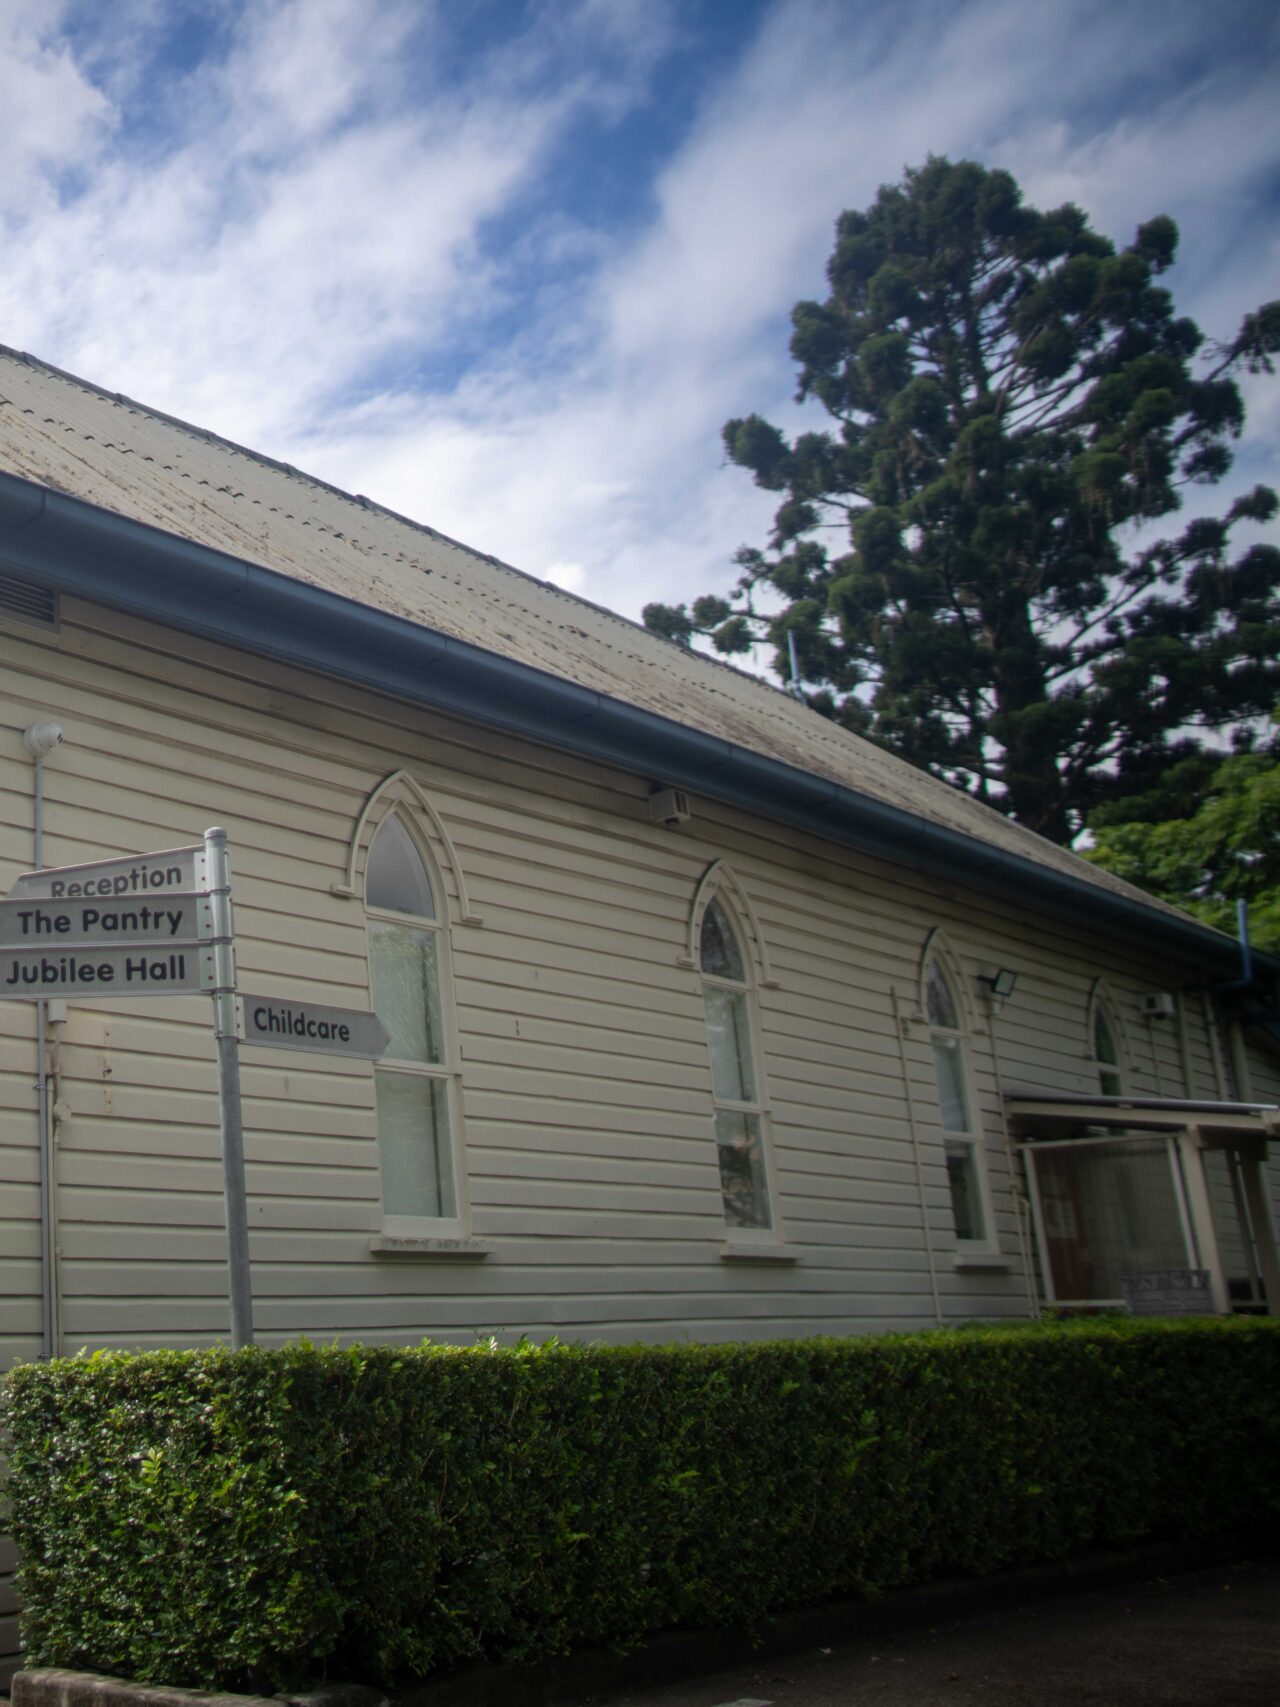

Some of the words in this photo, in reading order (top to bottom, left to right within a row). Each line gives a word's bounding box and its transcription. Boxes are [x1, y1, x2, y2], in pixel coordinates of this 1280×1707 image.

[51, 864, 182, 896] Reception
[17, 909, 72, 935] The
[82, 906, 183, 936] Pantry
[6, 956, 115, 985] Jubilee
[125, 954, 186, 982] Hall
[254, 1006, 351, 1043] Childcare
